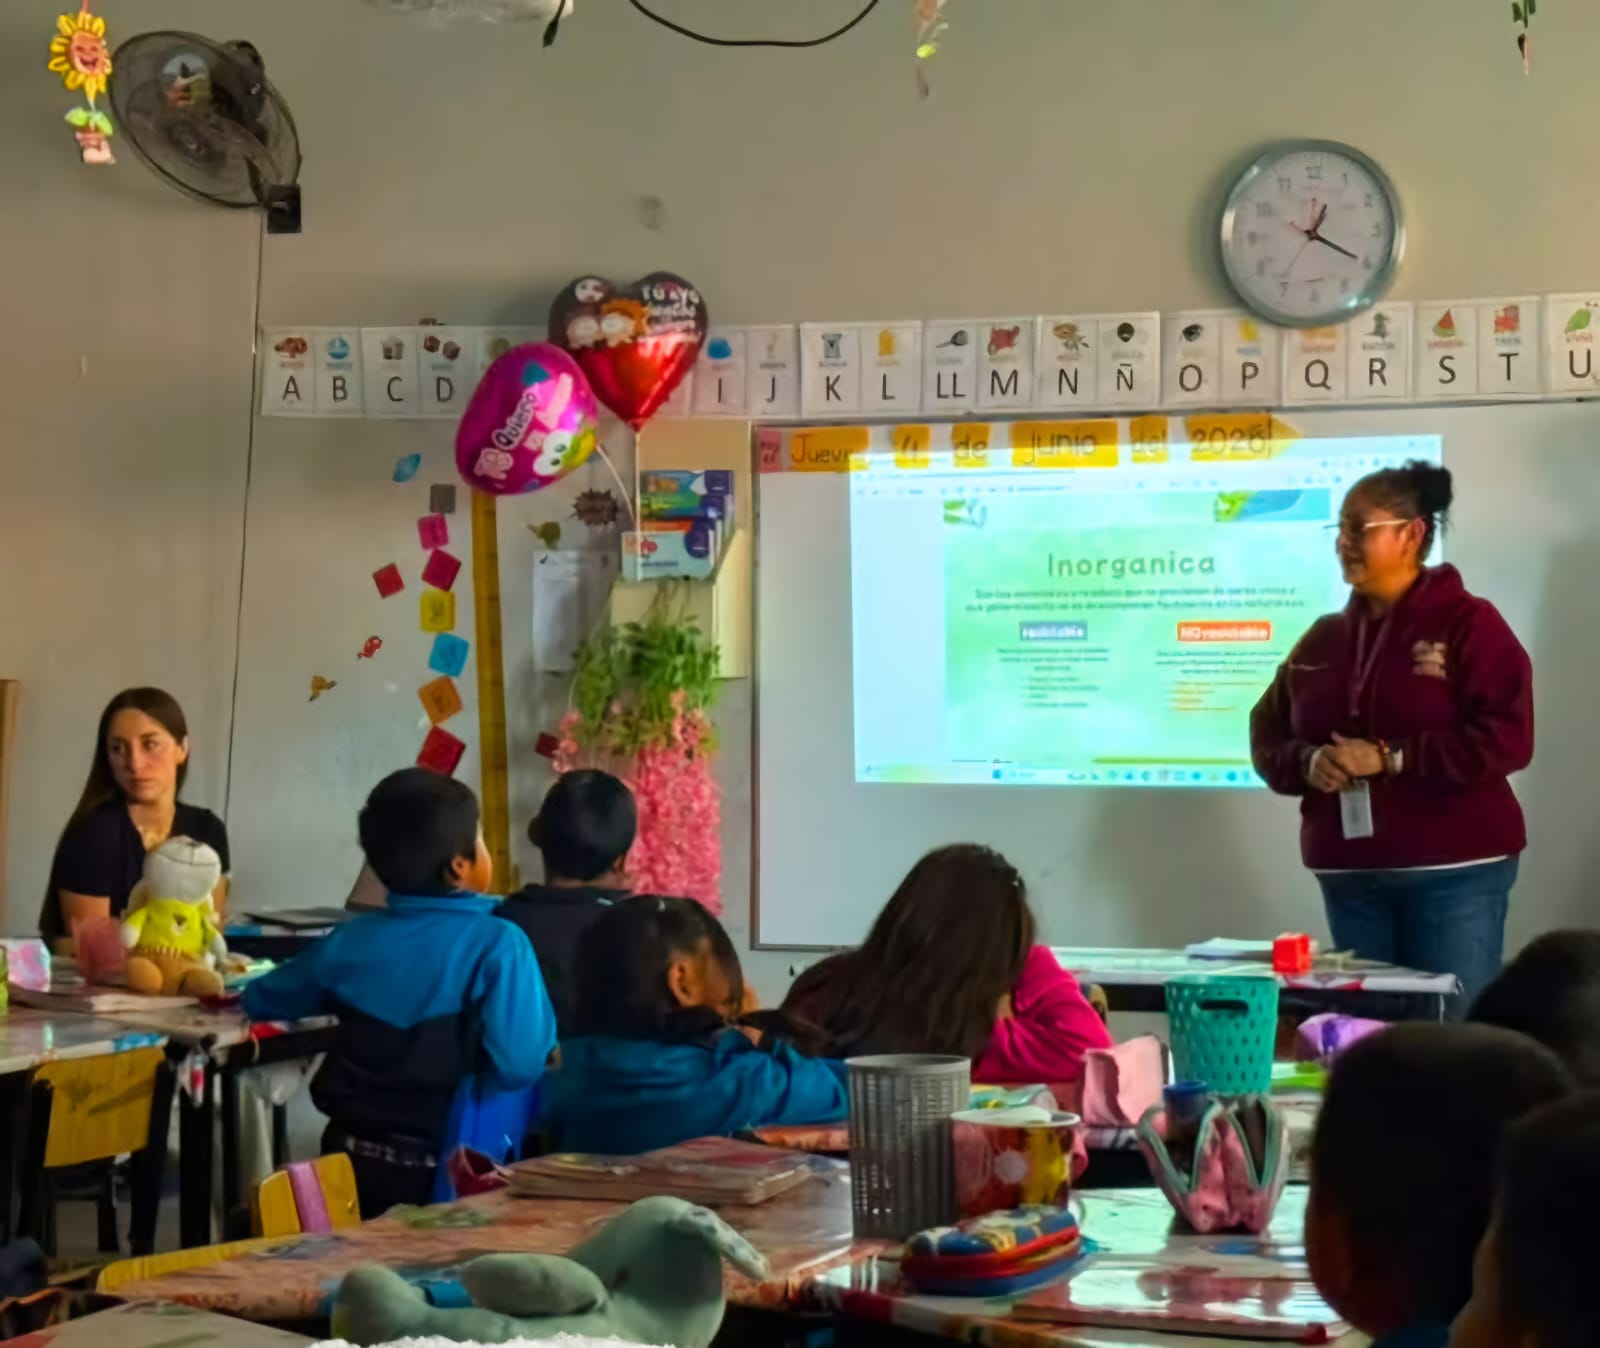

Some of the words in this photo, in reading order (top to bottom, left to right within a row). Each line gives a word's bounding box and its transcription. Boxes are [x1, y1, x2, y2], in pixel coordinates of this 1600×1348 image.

[283, 376, 300, 400] A
[332, 376, 348, 401] B
[387, 376, 403, 401] C
[436, 376, 454, 402] D
[765, 376, 776, 402] J
[826, 374, 842, 401] K
[882, 373, 895, 400] L
[937, 372, 966, 398] LL
[991, 369, 1018, 396] M
[1059, 368, 1078, 396] N
[1117, 363, 1133, 391] Ñ
[1179, 364, 1203, 392] O
[1242, 362, 1259, 390] P
[1305, 359, 1331, 390] Q
[1369, 358, 1387, 387] R
[1439, 355, 1456, 384] S
[1498, 353, 1519, 381] T
[1570, 348, 1591, 378] U
[954, 432, 988, 459] de
[1191, 422, 1266, 454] 2026
[1048, 551, 1215, 580] Inorganica
